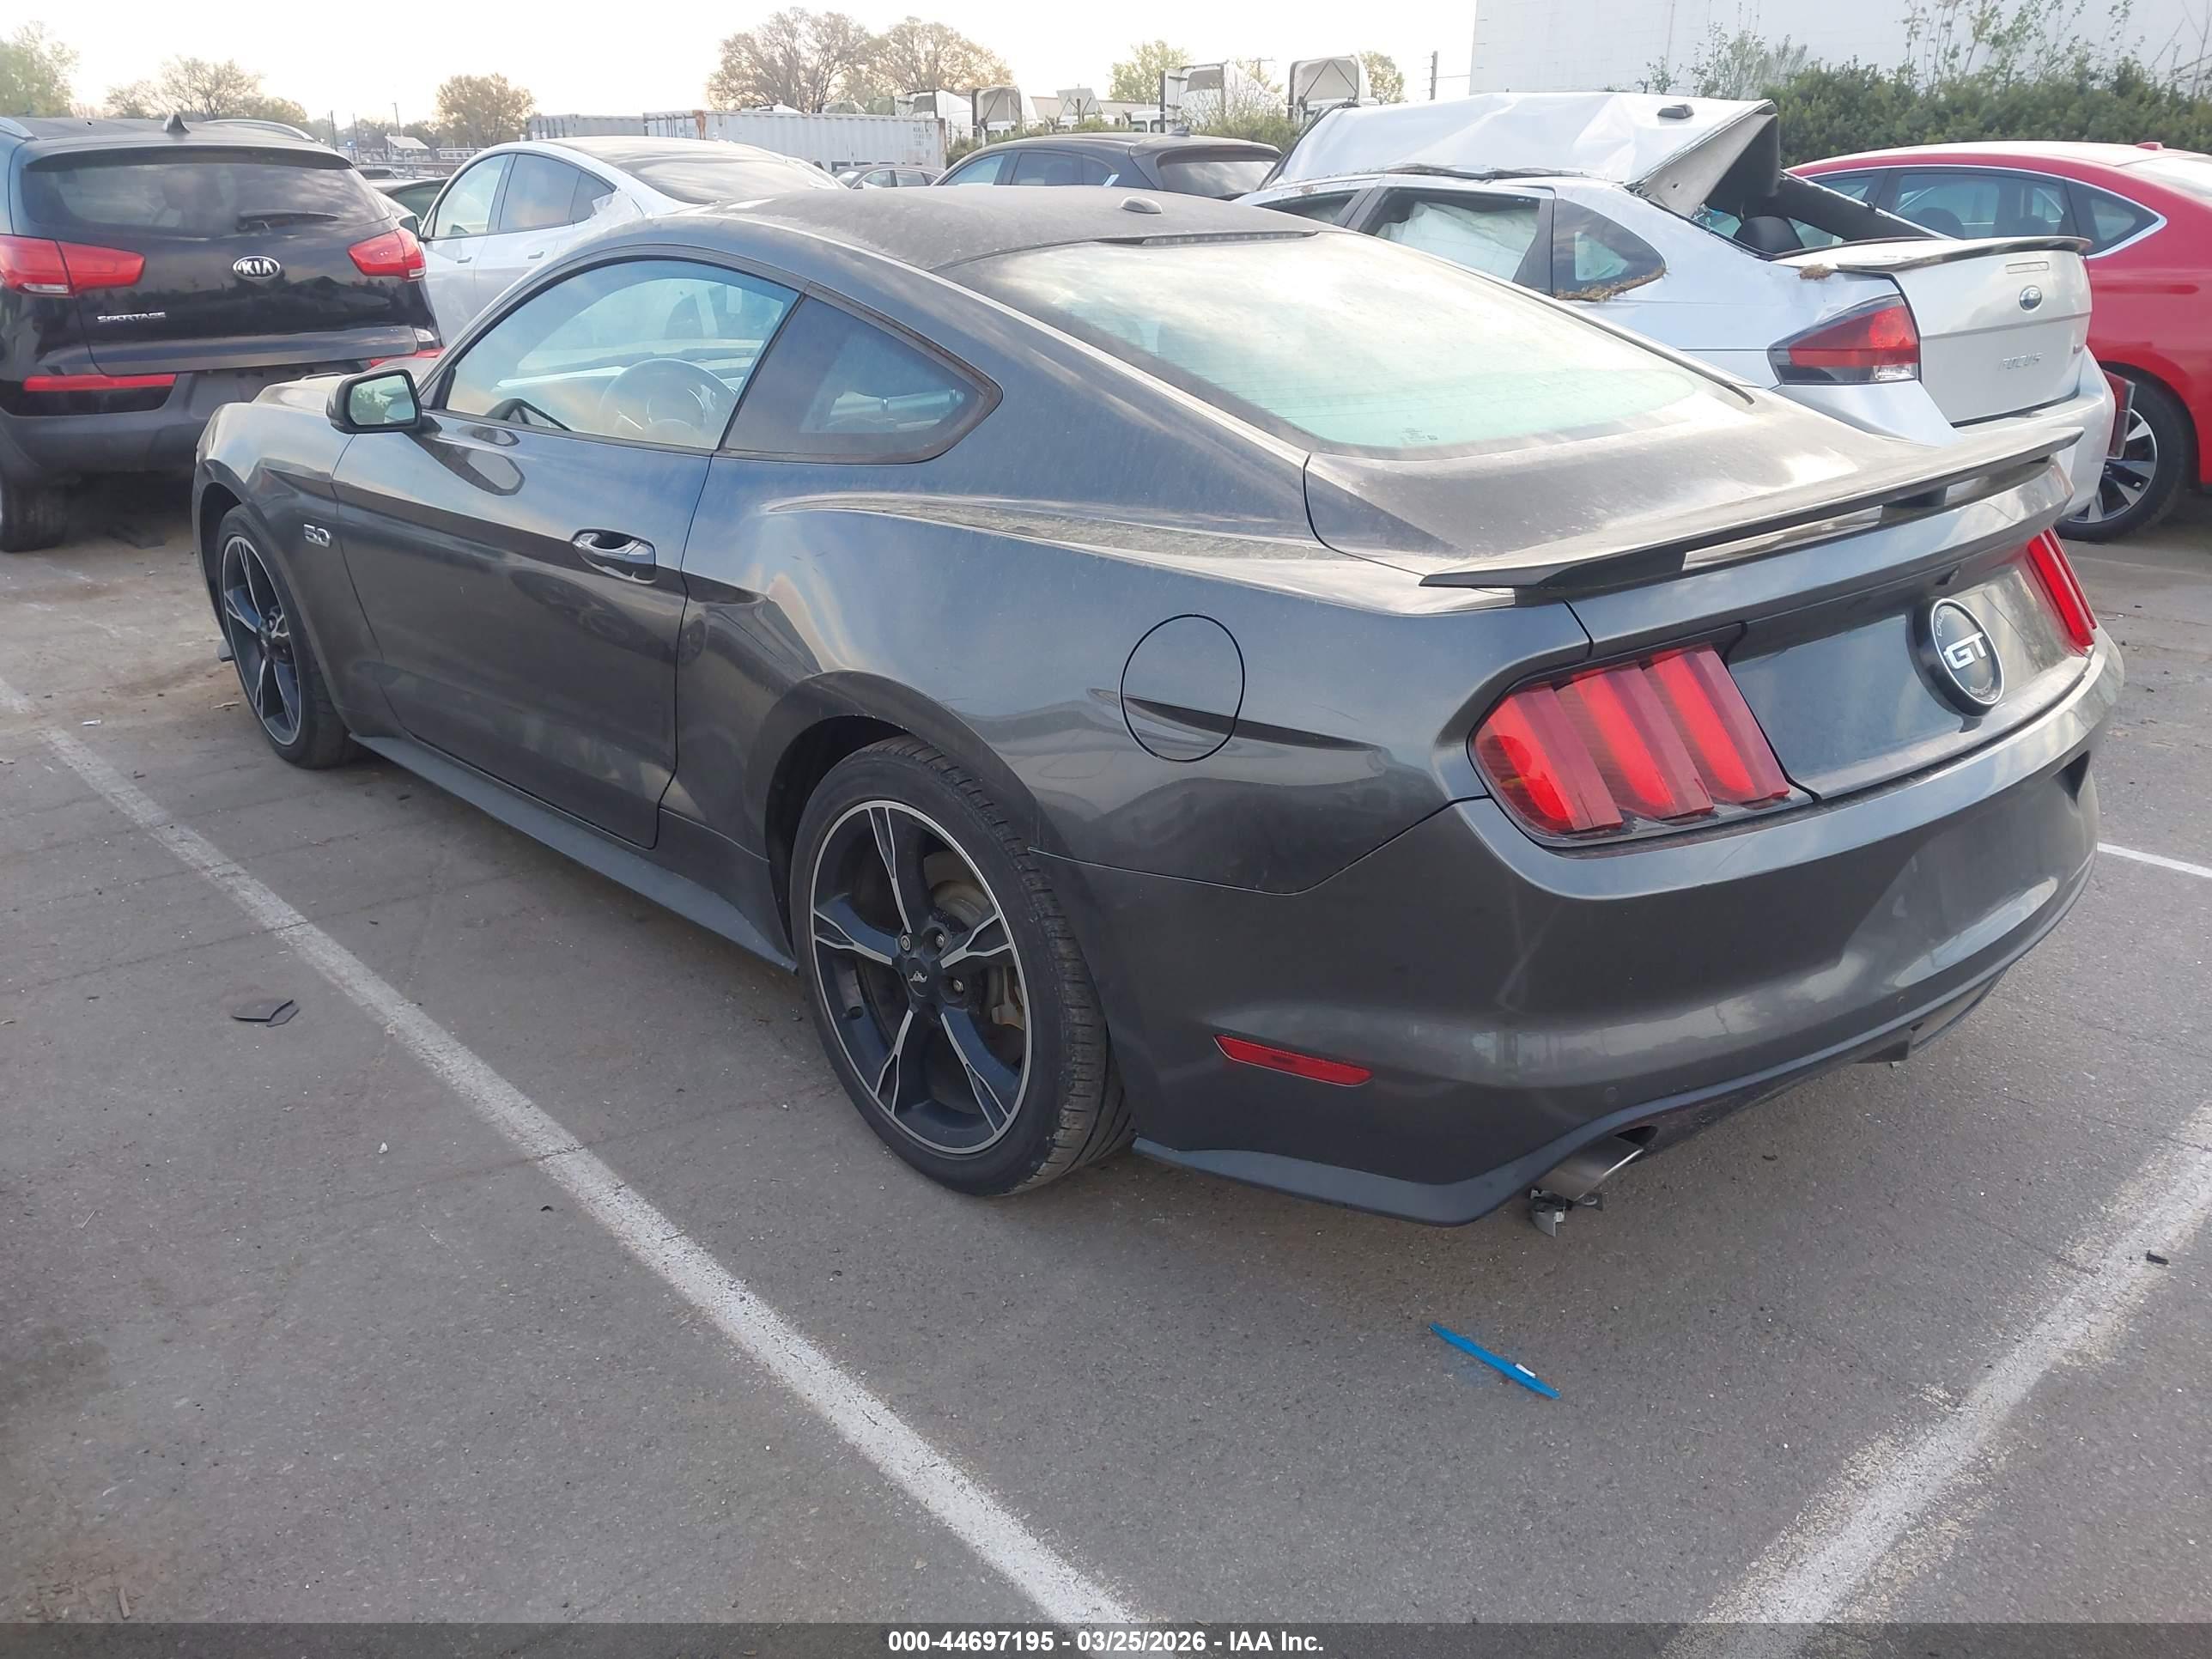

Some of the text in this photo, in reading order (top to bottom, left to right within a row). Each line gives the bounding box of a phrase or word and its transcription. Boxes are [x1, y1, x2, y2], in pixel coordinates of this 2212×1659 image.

[238, 259, 274, 275] KIA
[97, 312, 166, 323] SPORTAGE
[1943, 631, 1987, 669] GT
